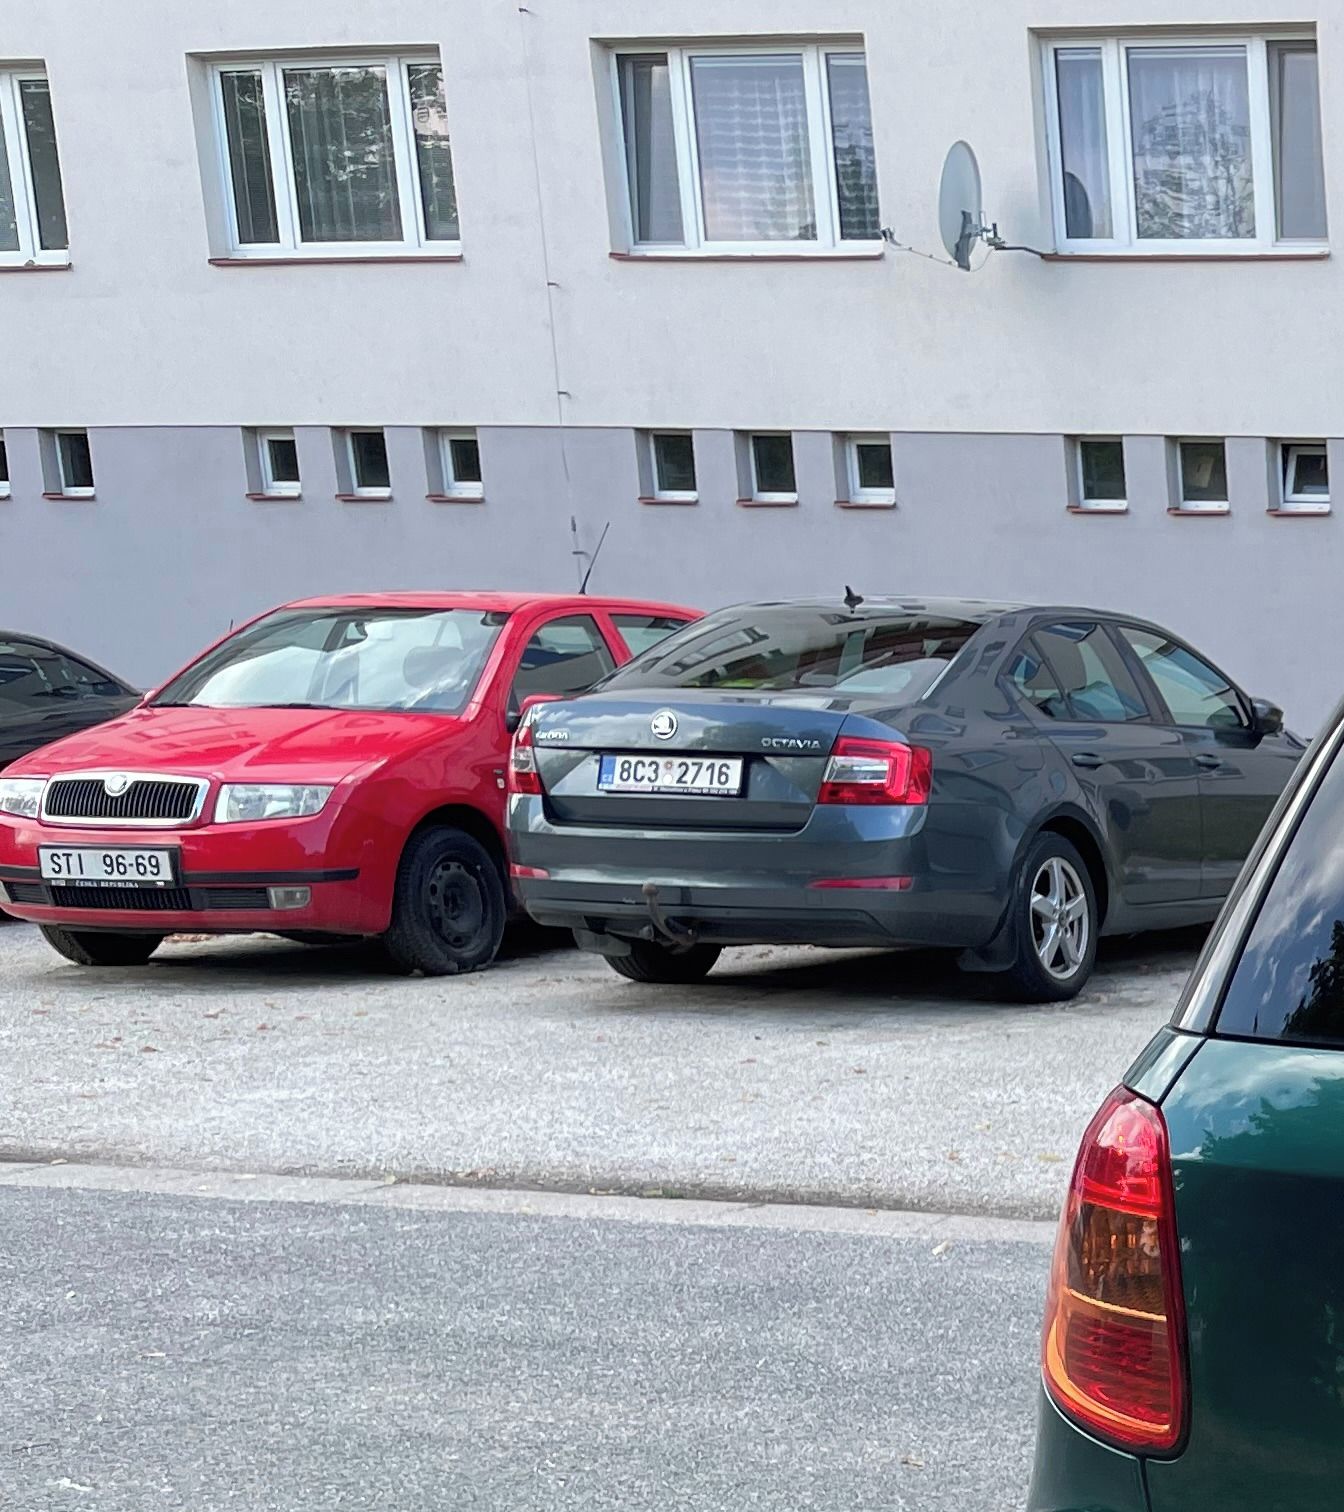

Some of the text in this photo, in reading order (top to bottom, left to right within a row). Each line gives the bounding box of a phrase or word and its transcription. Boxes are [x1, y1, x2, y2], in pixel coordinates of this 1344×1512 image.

[761, 737, 821, 750] OCTAVIA
[620, 760, 731, 786] 8C3 2716
[50, 853, 161, 876] STI 96-69
